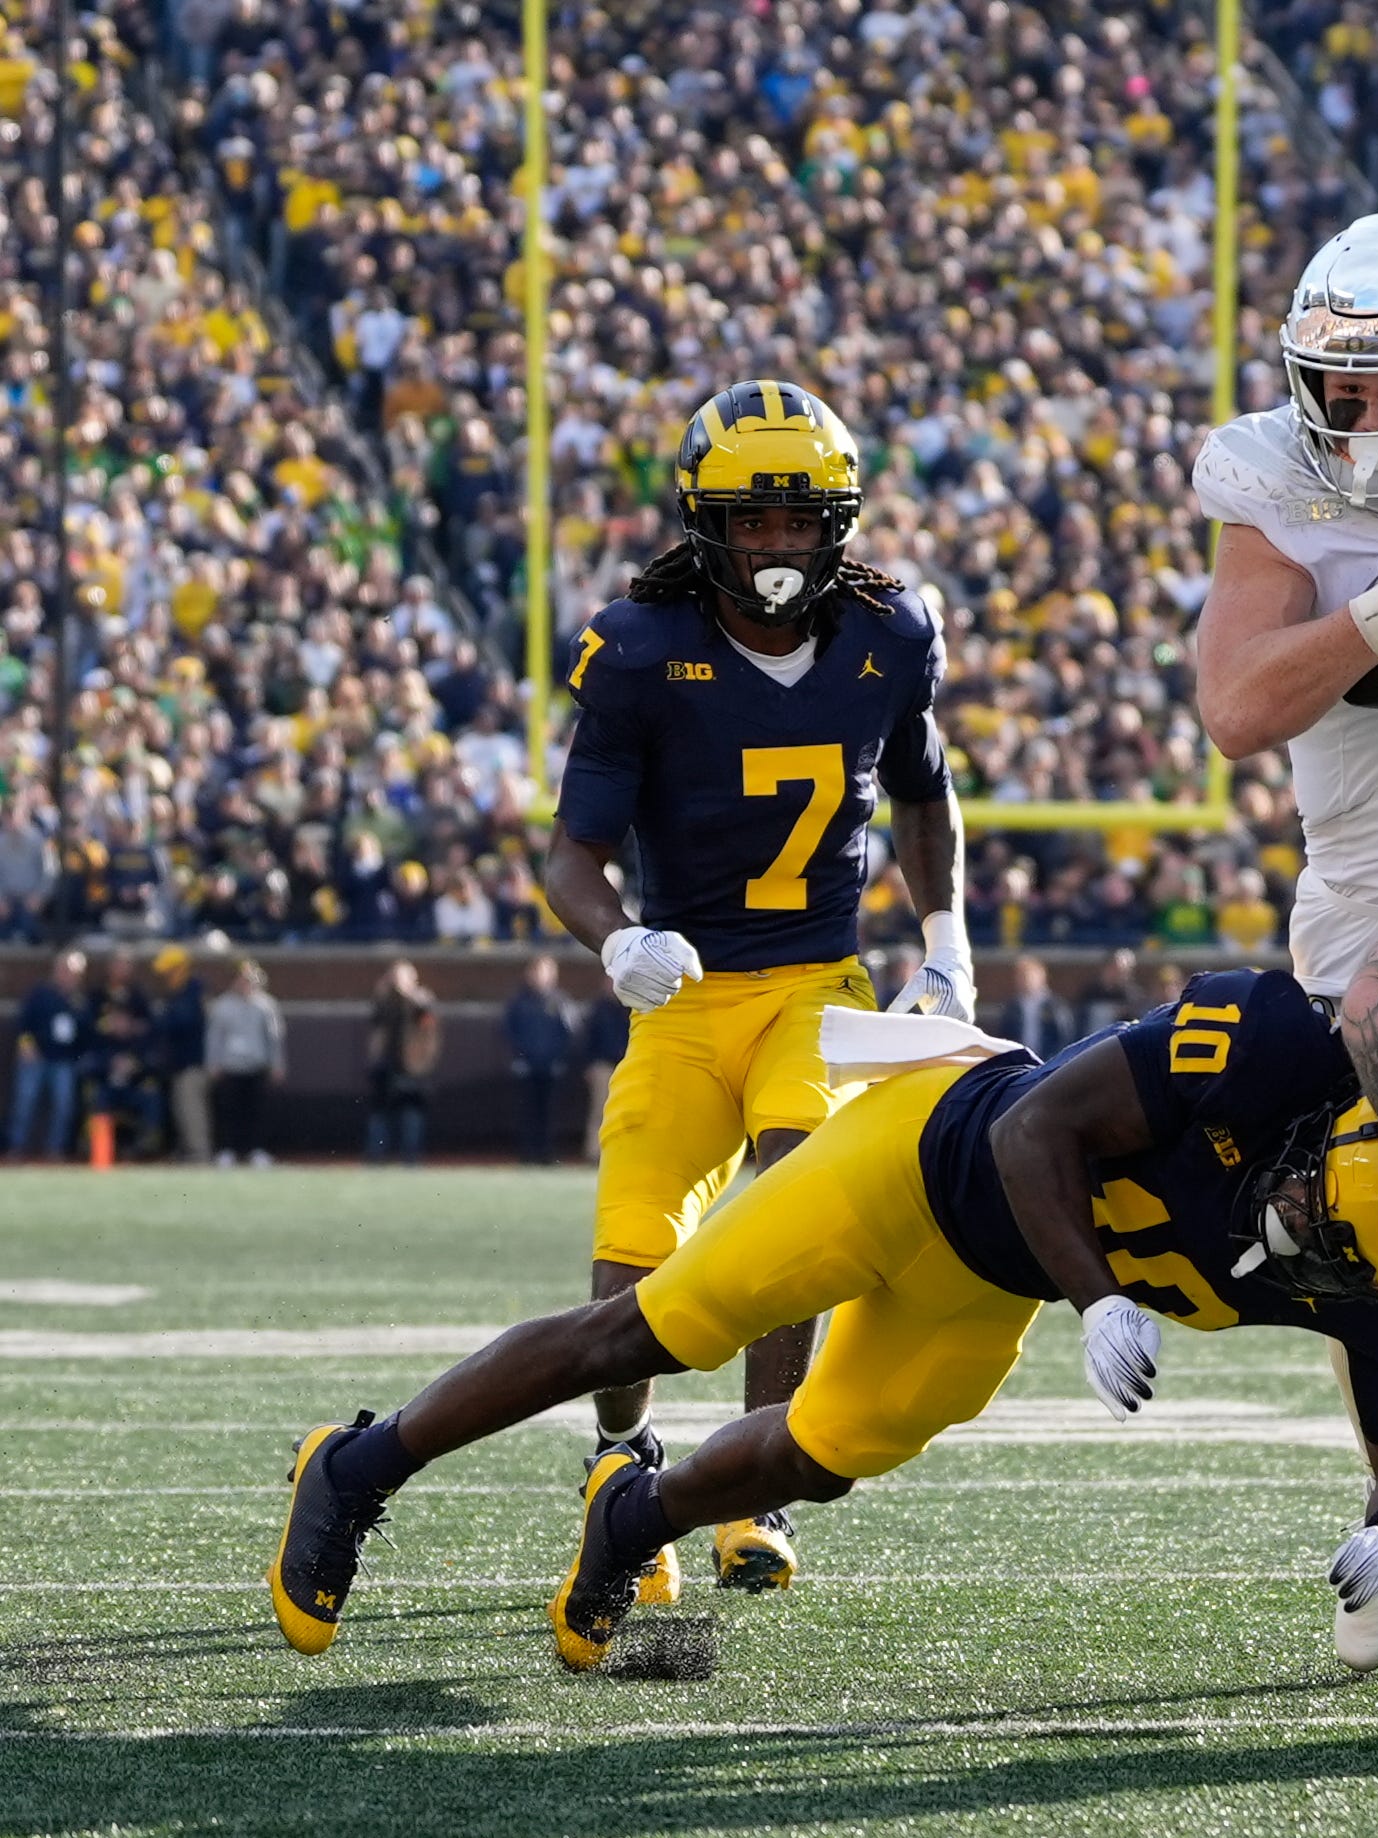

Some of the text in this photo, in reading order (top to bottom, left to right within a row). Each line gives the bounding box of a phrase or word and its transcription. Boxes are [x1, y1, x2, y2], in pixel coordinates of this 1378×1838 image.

[773, 475, 789, 487] M
[567, 628, 605, 690] 7
[742, 743, 845, 910] 7
[1169, 1002, 1241, 1074] 10
[315, 1590, 337, 1610] M
